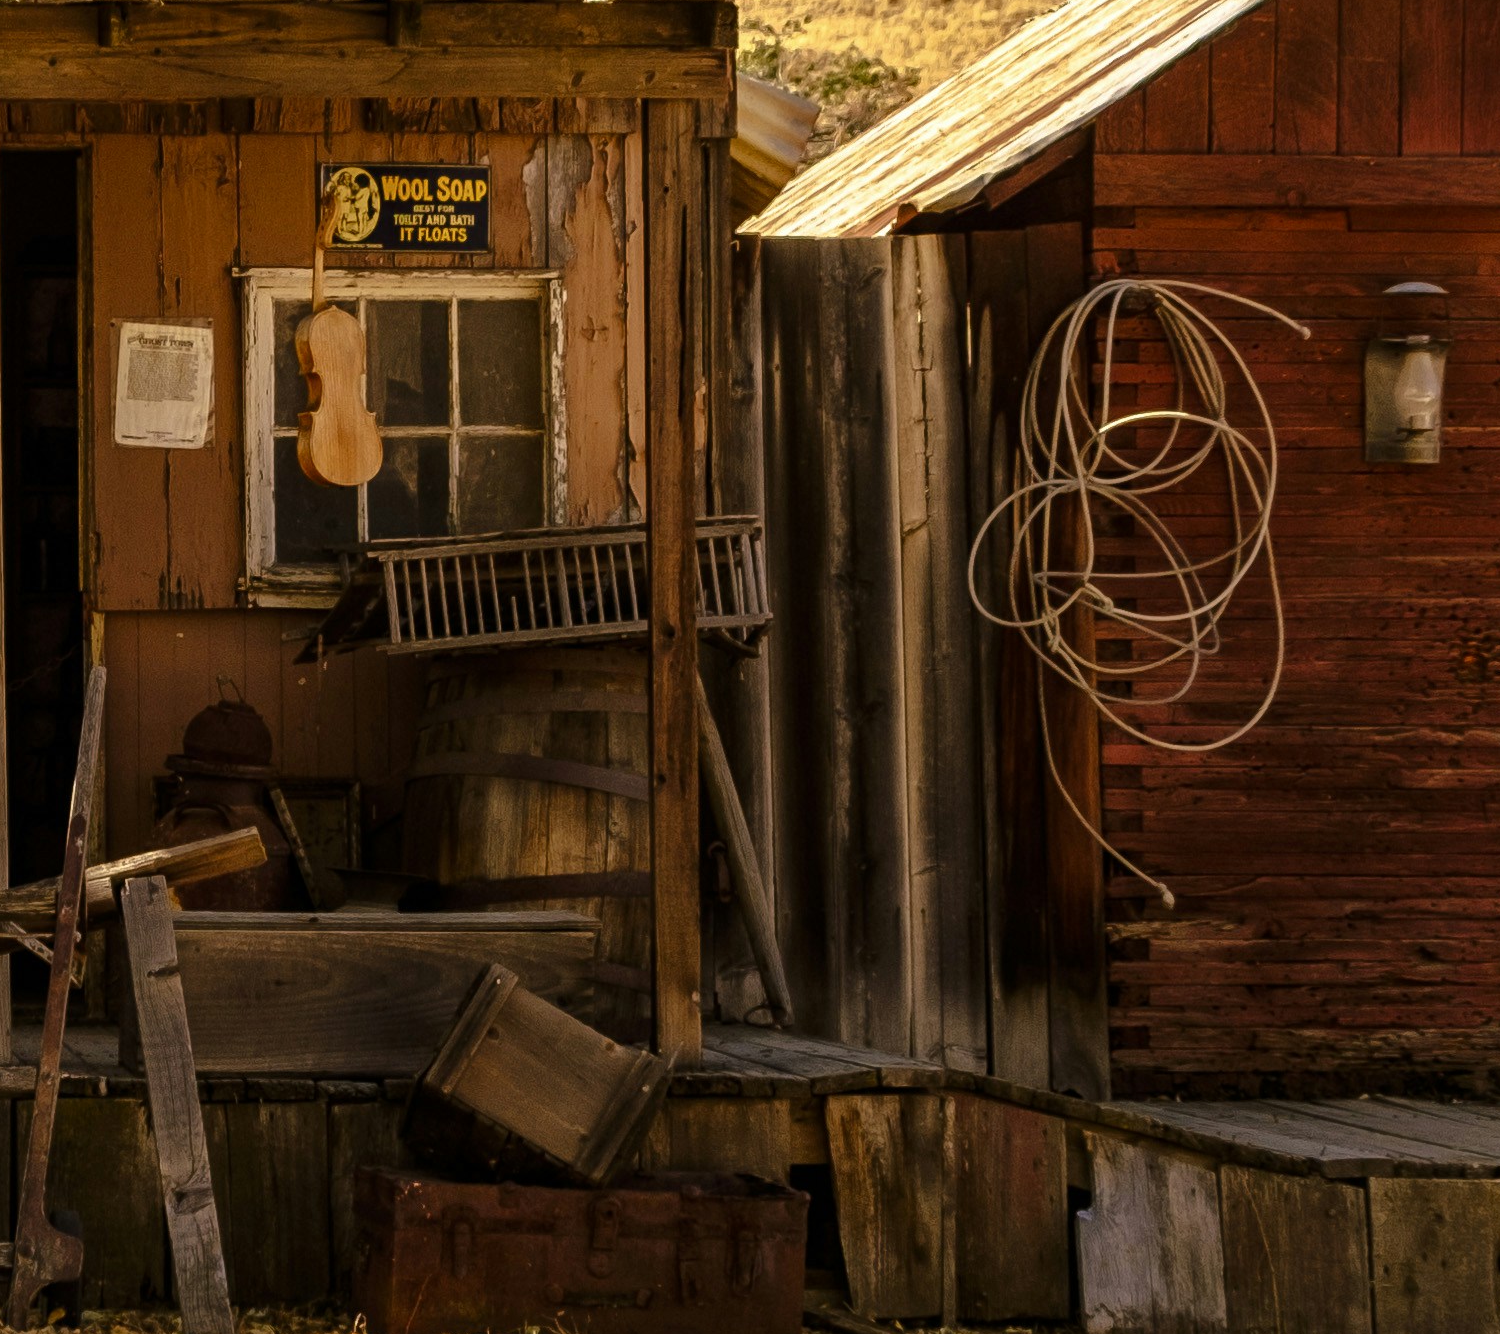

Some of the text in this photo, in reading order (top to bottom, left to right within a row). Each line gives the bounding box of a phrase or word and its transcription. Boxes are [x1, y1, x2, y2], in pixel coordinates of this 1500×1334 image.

[381, 175, 488, 203] WOOL SOAP
[393, 213, 475, 226] TOILET AND BATH
[400, 227, 468, 243] IT FLOATS
